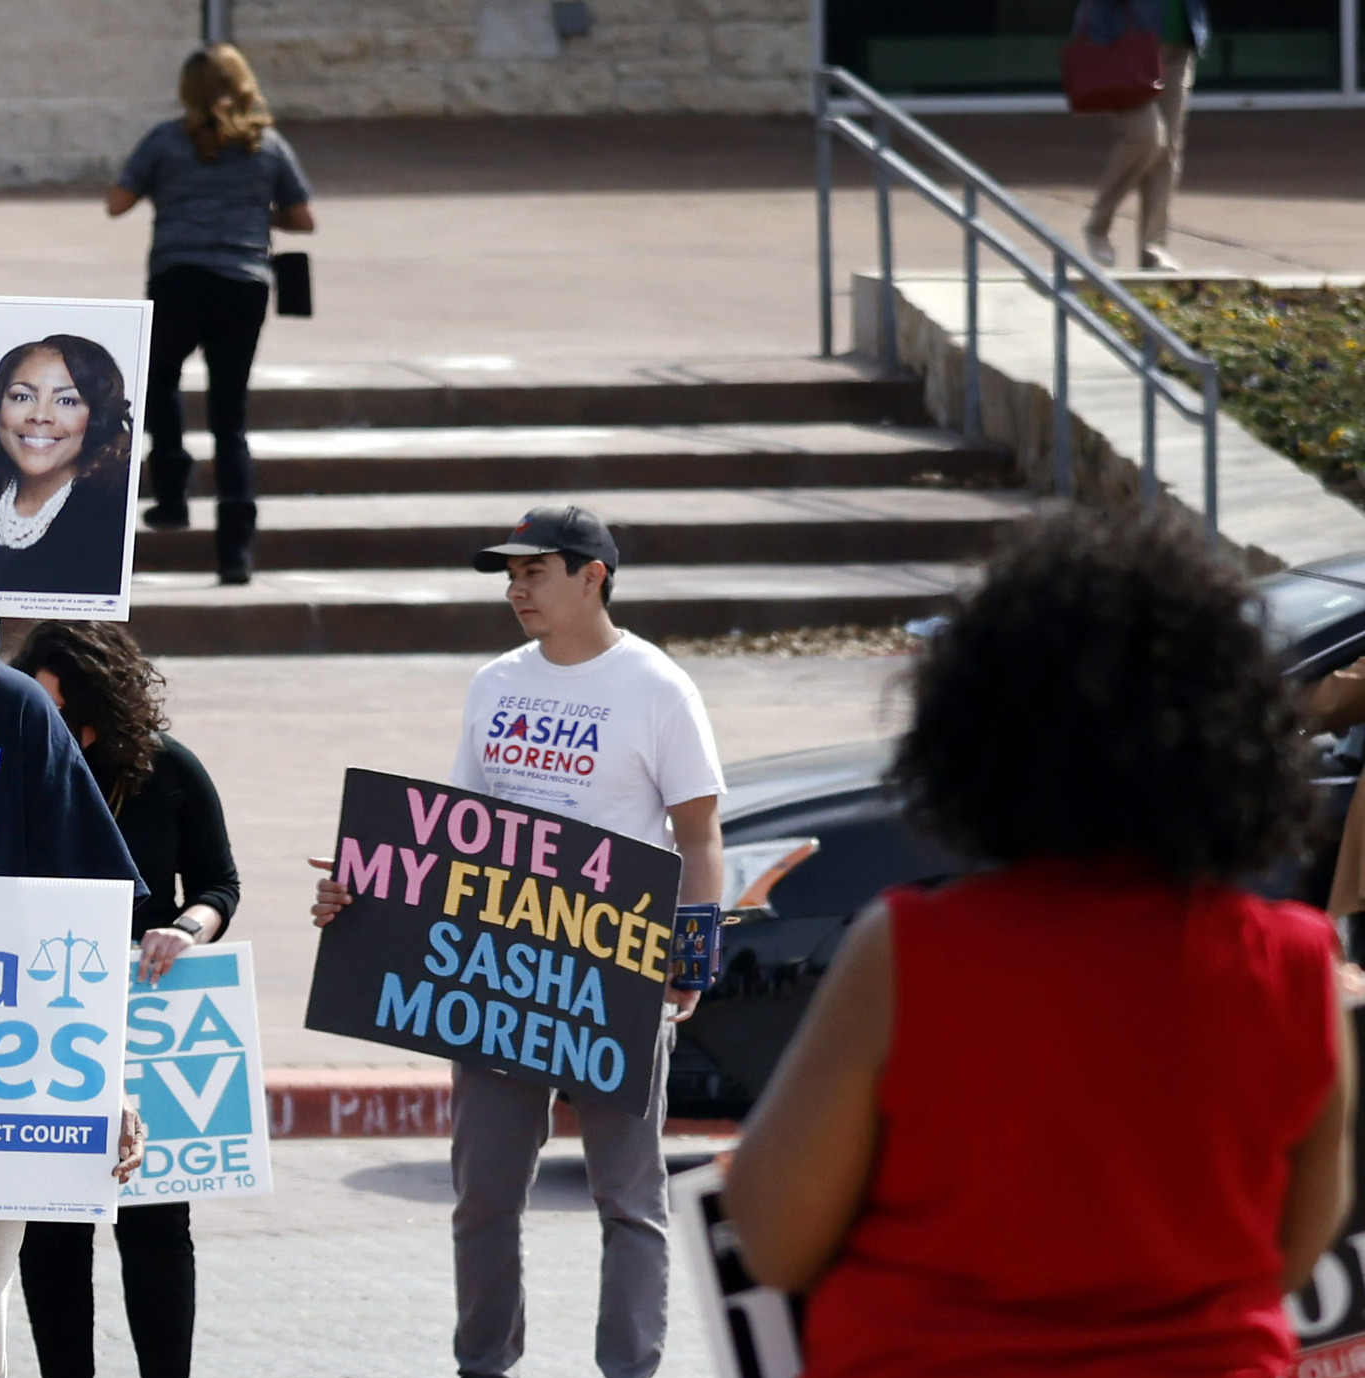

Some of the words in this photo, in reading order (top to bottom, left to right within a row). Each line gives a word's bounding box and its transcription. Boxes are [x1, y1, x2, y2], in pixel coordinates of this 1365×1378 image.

[488, 711, 599, 752] SASHA
[497, 696, 559, 713] RE-ELECT
[561, 703, 611, 721] JUDGE
[483, 742, 595, 776] MORENO
[406, 787, 562, 879] VOTE
[581, 837, 612, 893] 4
[336, 837, 439, 906] MY
[443, 860, 672, 984] FIANCÉE
[424, 921, 607, 1027] SASHA
[126, 993, 245, 1055] SA
[375, 972, 627, 1093] MORENO
[20, 1125, 92, 1145] COURT
[156, 1176, 227, 1194] COURT
[235, 1174, 255, 1188] 10
